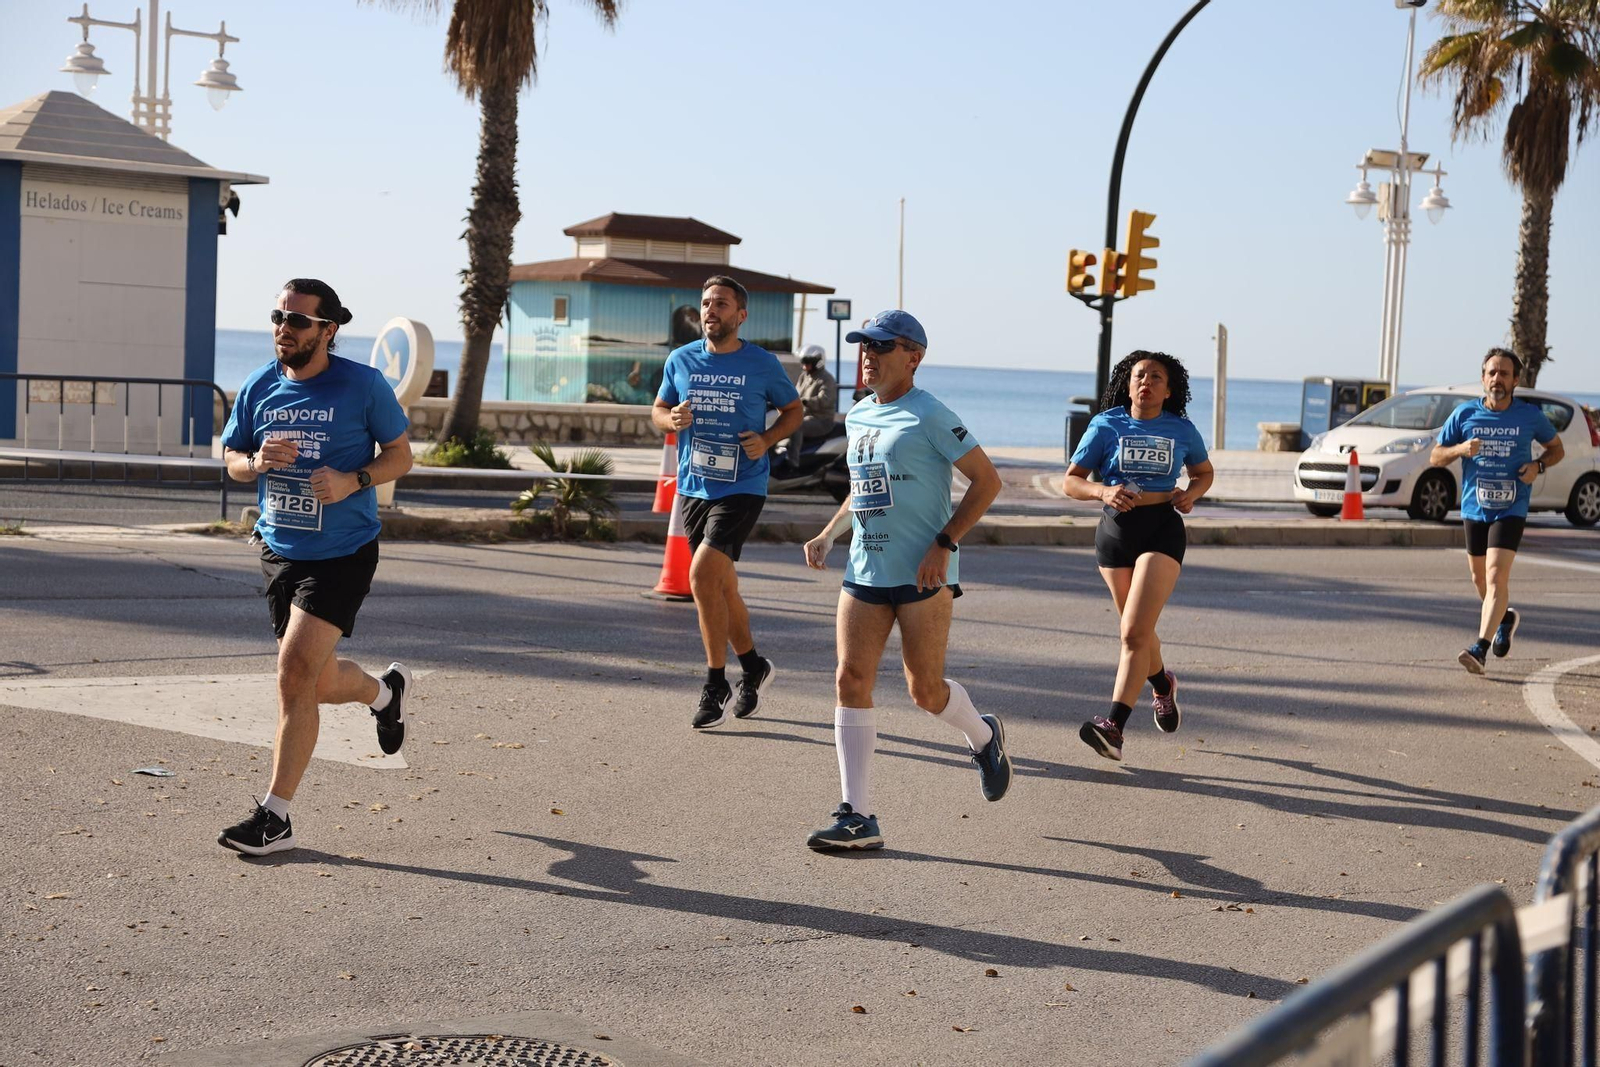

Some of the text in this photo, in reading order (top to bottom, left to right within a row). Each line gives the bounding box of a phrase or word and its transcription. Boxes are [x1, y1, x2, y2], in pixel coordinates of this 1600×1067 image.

[25, 190, 184, 221] Helados / Ice Creams
[689, 373, 746, 386] mayoral
[688, 389, 741, 400] RUNNING
[691, 396, 736, 406] MAKES
[690, 403, 736, 413] FRIENDS
[262, 406, 334, 424] mayoral
[1472, 426, 1520, 437] mayoral
[707, 455, 717, 467] 8
[1127, 449, 1167, 462] 1726
[268, 493, 315, 513] 2126
